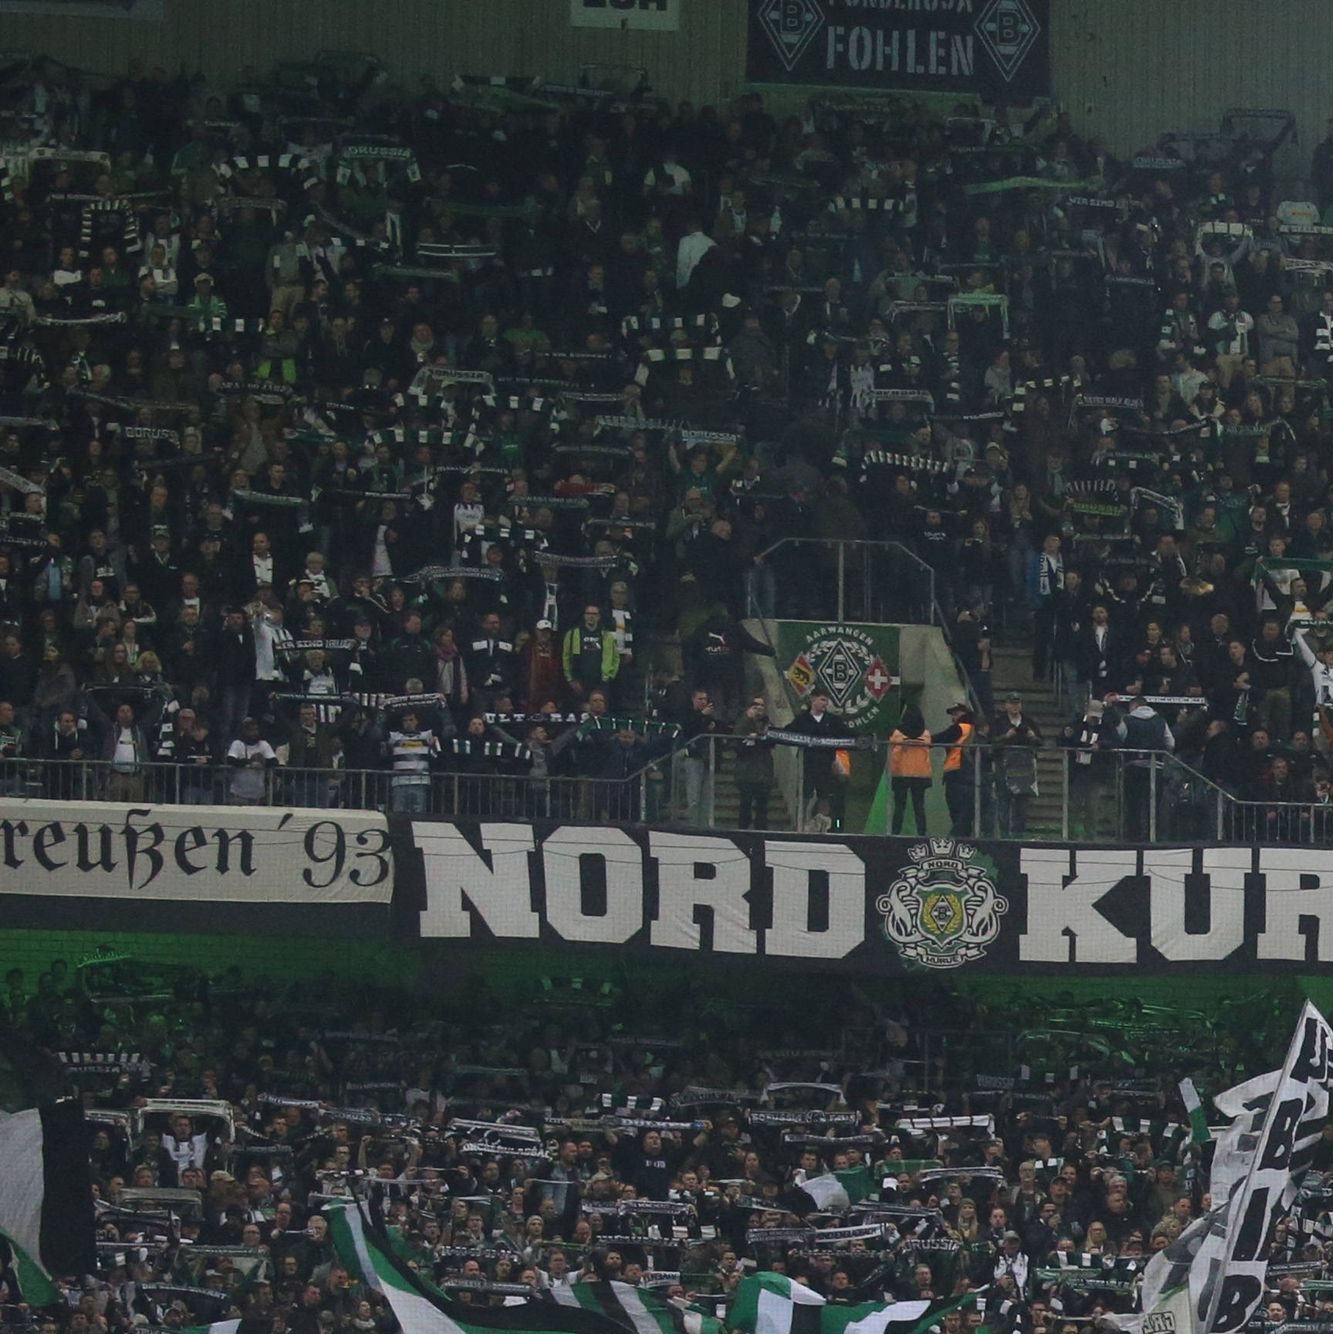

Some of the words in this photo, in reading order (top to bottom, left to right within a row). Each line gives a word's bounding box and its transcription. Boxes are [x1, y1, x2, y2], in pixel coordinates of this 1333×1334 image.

[826, 26, 974, 76] FOHLEN
[806, 627, 875, 647] AARWANGEN
[843, 706, 881, 729] OHLEN
[411, 820, 866, 960] NORD
